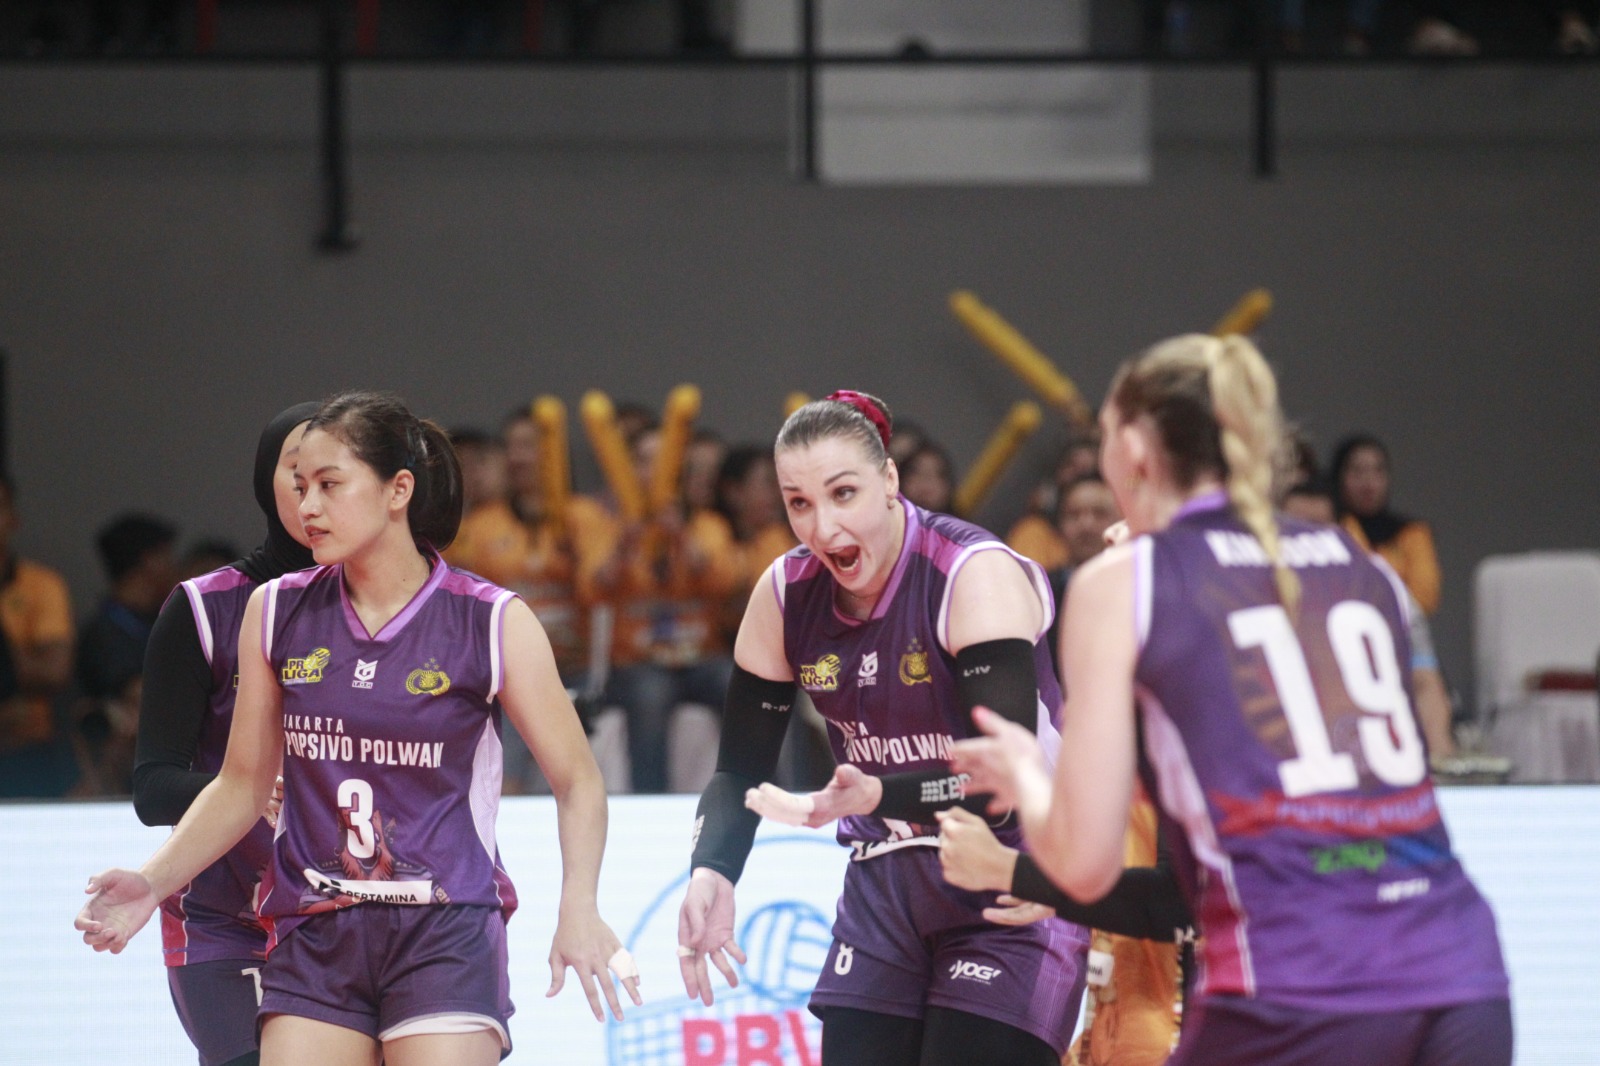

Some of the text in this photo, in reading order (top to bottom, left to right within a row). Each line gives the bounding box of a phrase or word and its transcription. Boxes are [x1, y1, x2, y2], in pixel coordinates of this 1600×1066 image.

[284, 669, 320, 680] LIGA
[802, 675, 835, 686] LIGA
[1226, 600, 1427, 798] 19
[284, 730, 444, 768] POPSIVO POLWAN
[337, 778, 374, 859] 3
[834, 942, 855, 976] 8
